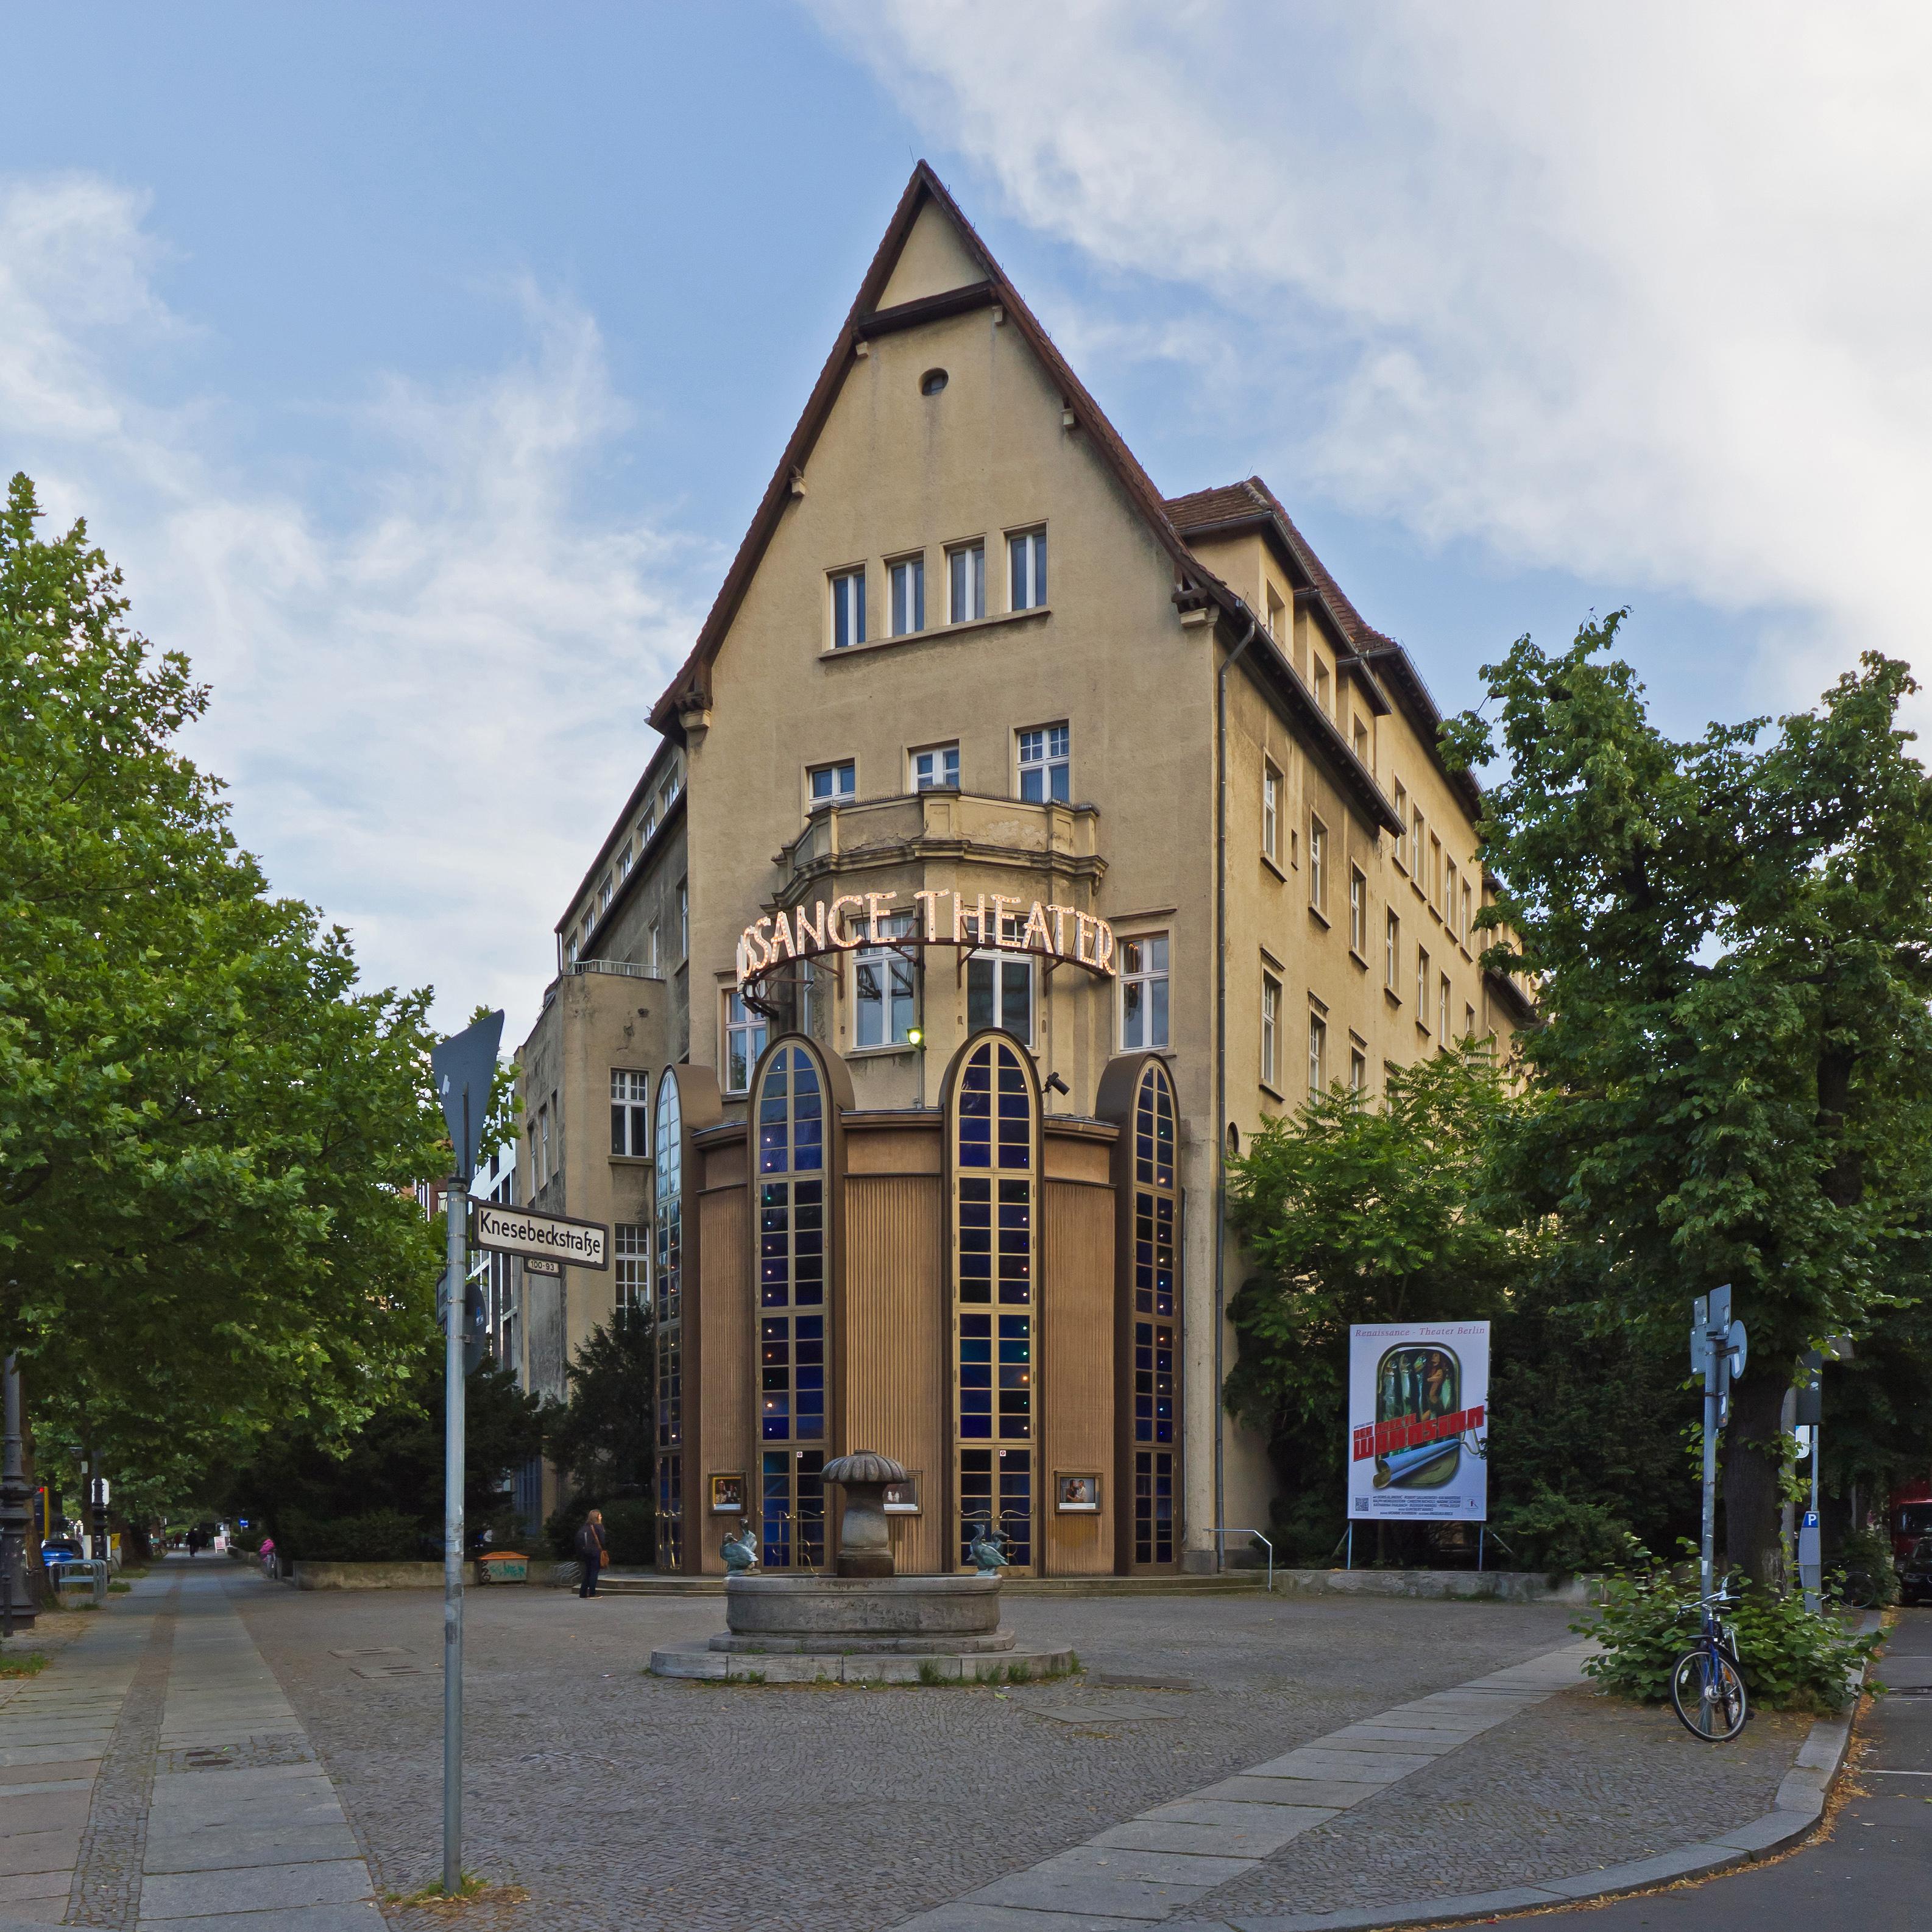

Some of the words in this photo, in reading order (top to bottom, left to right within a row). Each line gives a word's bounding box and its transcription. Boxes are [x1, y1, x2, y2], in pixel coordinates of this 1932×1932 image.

[913, 888, 1116, 976] THEATER
[480, 1210, 601, 1256] Knesebeckstraße
[1420, 1327, 1454, 1336] Theater
[1457, 1326, 1485, 1334] Berlin
[1808, 1514, 1817, 1525] P
